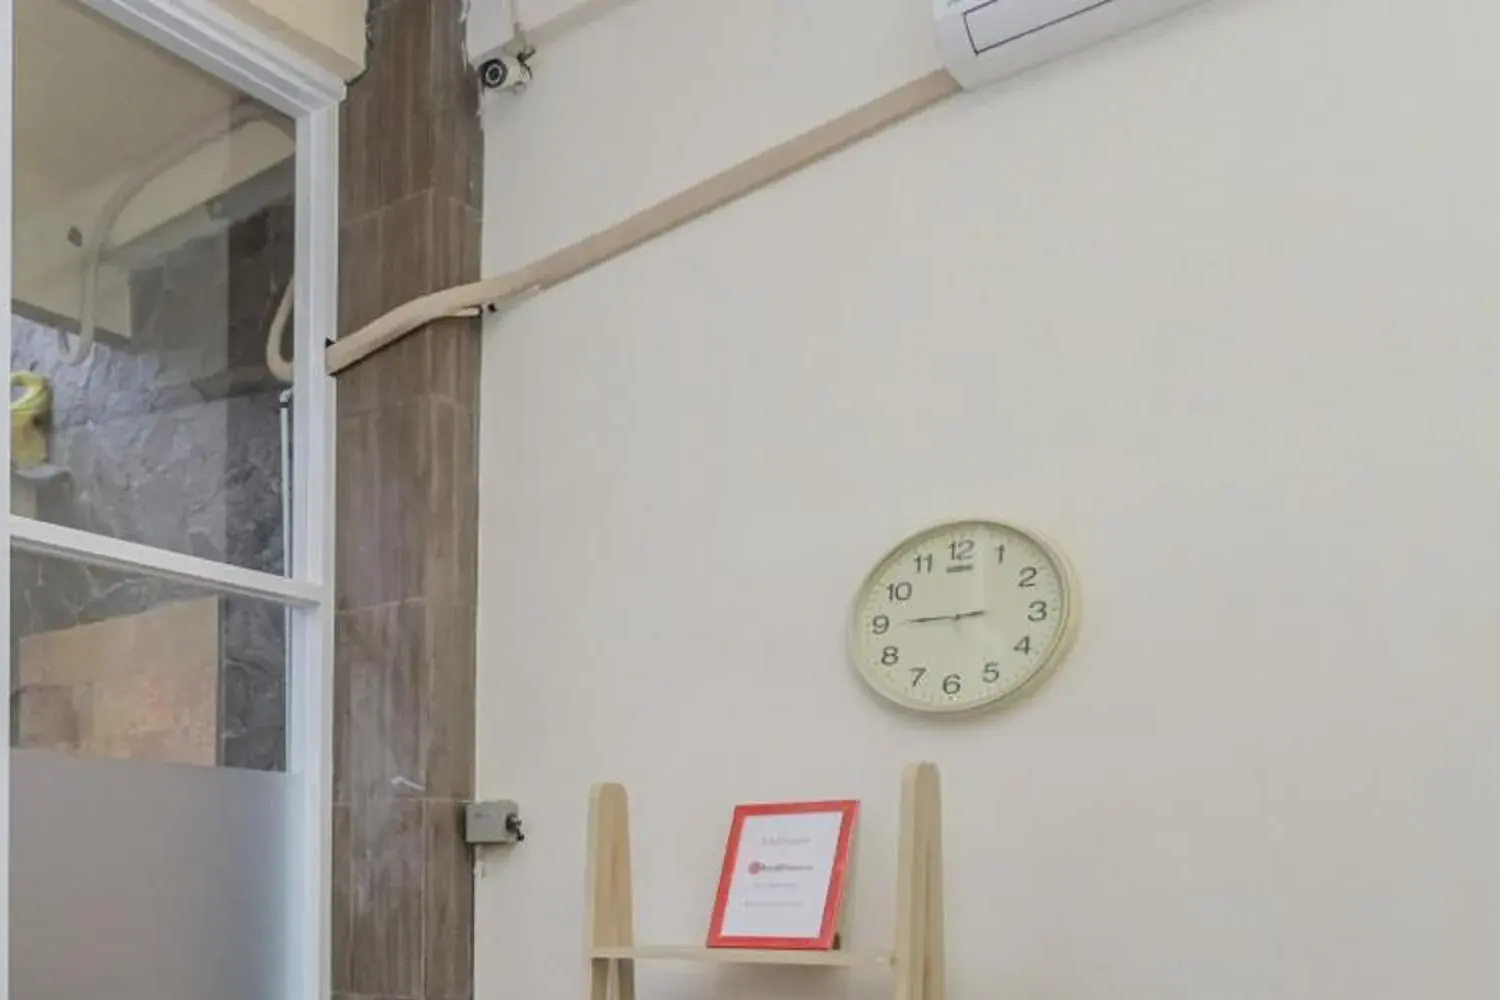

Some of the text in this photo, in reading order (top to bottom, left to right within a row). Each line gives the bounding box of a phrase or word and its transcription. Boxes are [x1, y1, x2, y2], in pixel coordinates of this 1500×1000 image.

[948, 539, 975, 560] 12
[995, 544, 1006, 564] 1
[913, 554, 933, 573] 11
[1018, 566, 1038, 587] 2
[886, 581, 913, 601] 10
[1027, 600, 1048, 622] 3
[871, 614, 890, 635] 9
[1012, 635, 1032, 655] 4
[880, 646, 900, 666] 8
[909, 667, 927, 687] 7
[982, 661, 1000, 683] 5
[942, 673, 961, 694] 6
